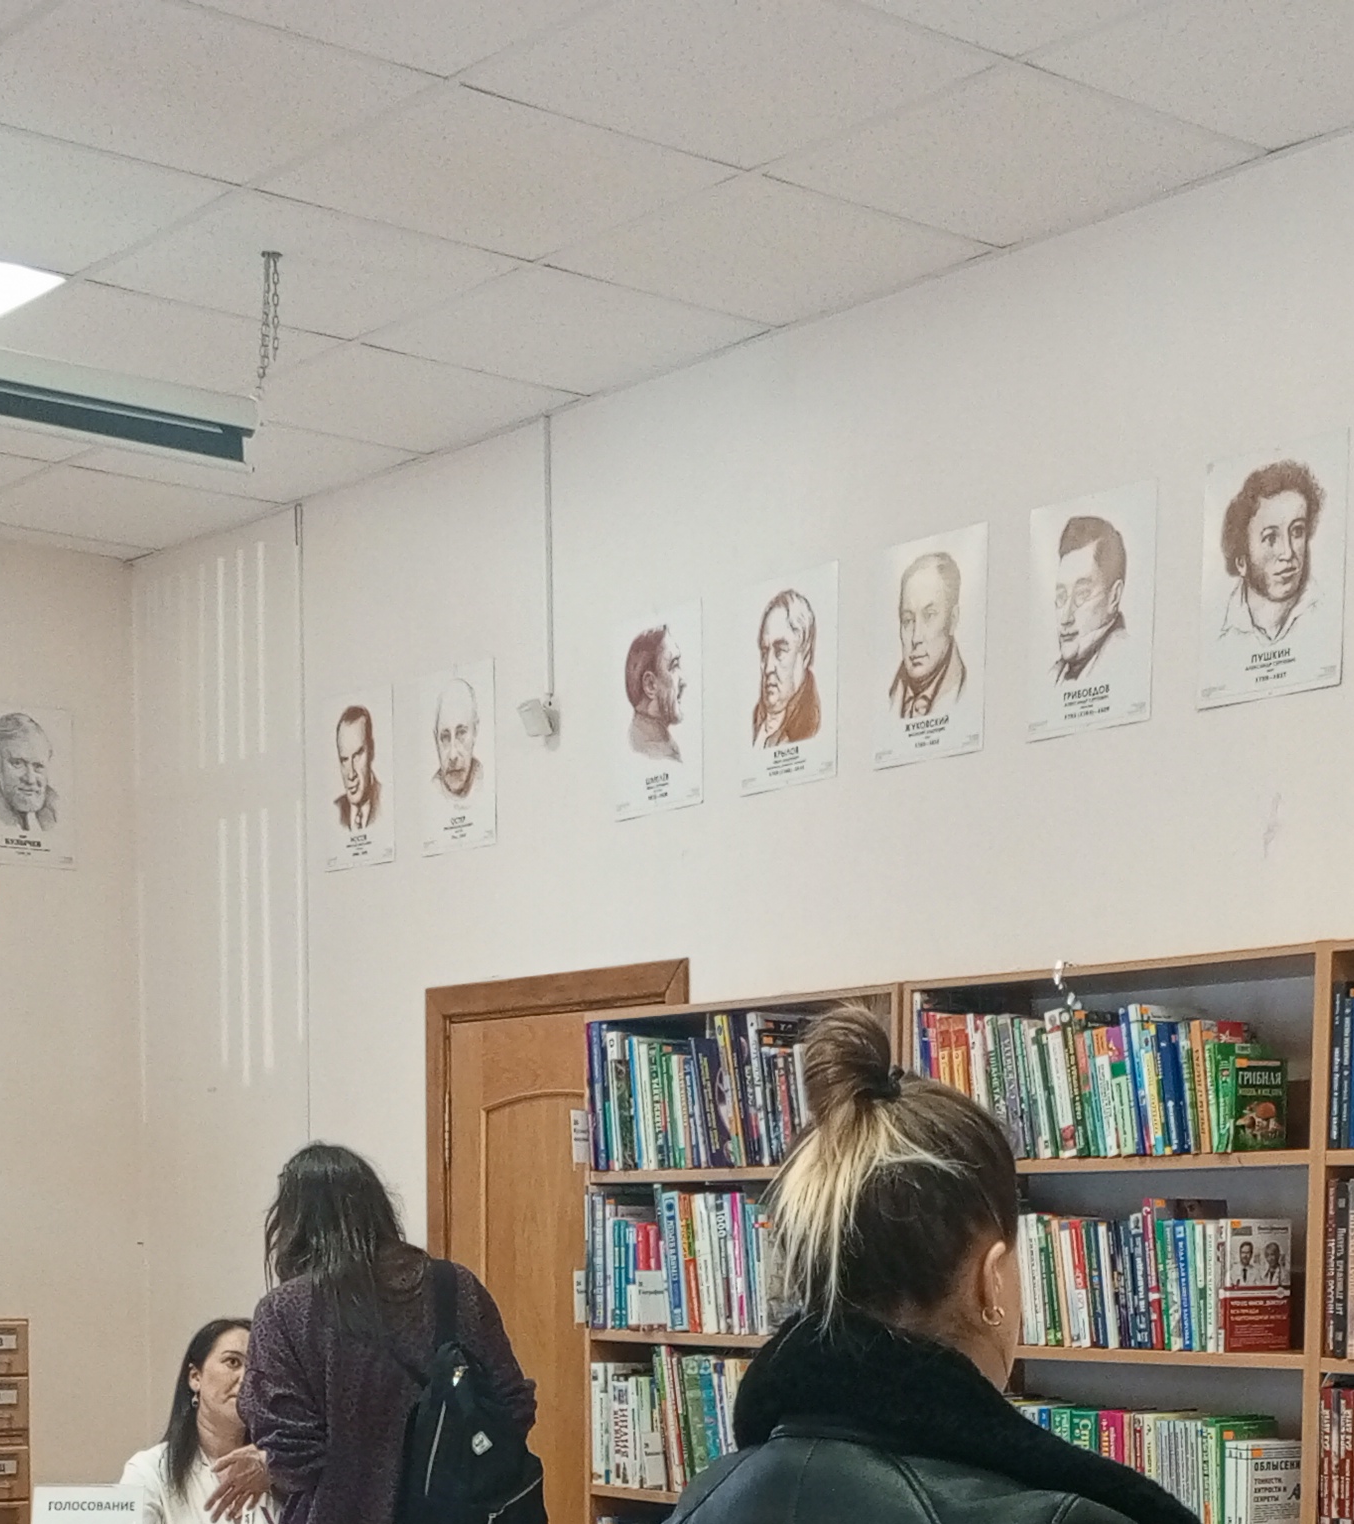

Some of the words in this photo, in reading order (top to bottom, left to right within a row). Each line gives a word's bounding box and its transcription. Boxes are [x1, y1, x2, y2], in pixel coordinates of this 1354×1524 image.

[1251, 648, 1291, 663] ПУШКИН
[1063, 684, 1110, 701] ГРИБОЕДОВ
[48, 1501, 135, 1511] ГОЛОСОВАНИЕ
